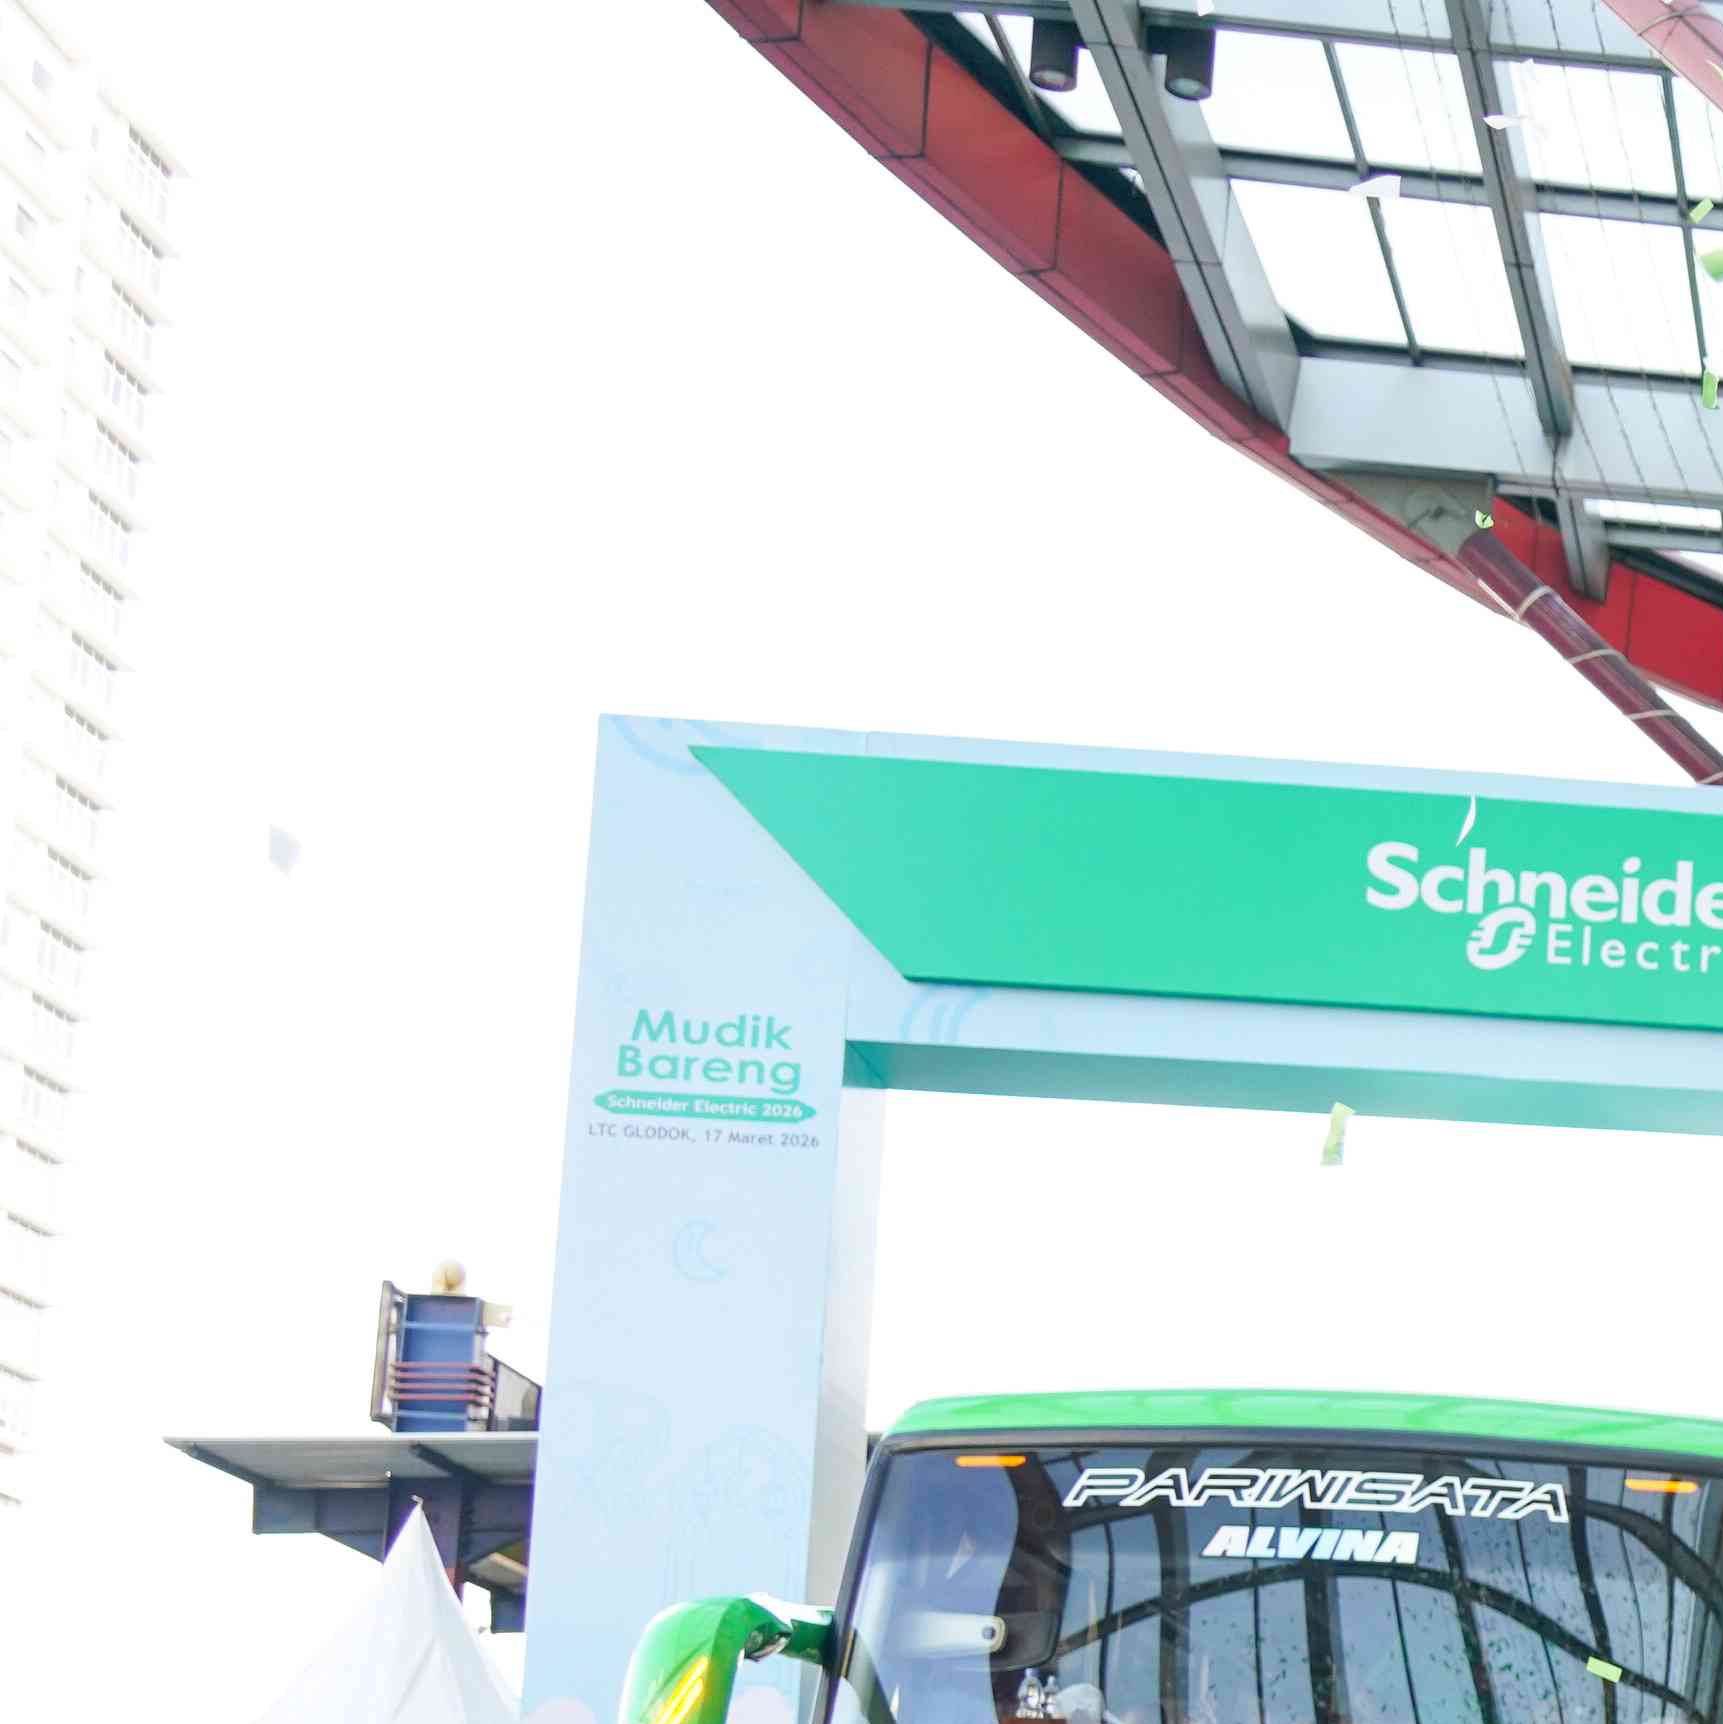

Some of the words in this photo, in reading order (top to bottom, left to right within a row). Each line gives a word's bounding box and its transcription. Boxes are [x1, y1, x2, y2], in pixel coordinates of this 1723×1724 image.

[631, 1008, 793, 1050] Mudik
[616, 1044, 802, 1095] Bareng
[606, 1094, 688, 1114] Schneider
[693, 1098, 757, 1117] Electric
[762, 1103, 804, 1118] 2026
[588, 1122, 617, 1137] LTC
[623, 1123, 697, 1142] GLODOK,
[704, 1129, 723, 1142] 17
[728, 1130, 773, 1146] Maret
[780, 1133, 820, 1148] 2026
[1062, 1467, 1570, 1523] PARIWISATA
[1200, 1525, 1420, 1565] ALVINA
